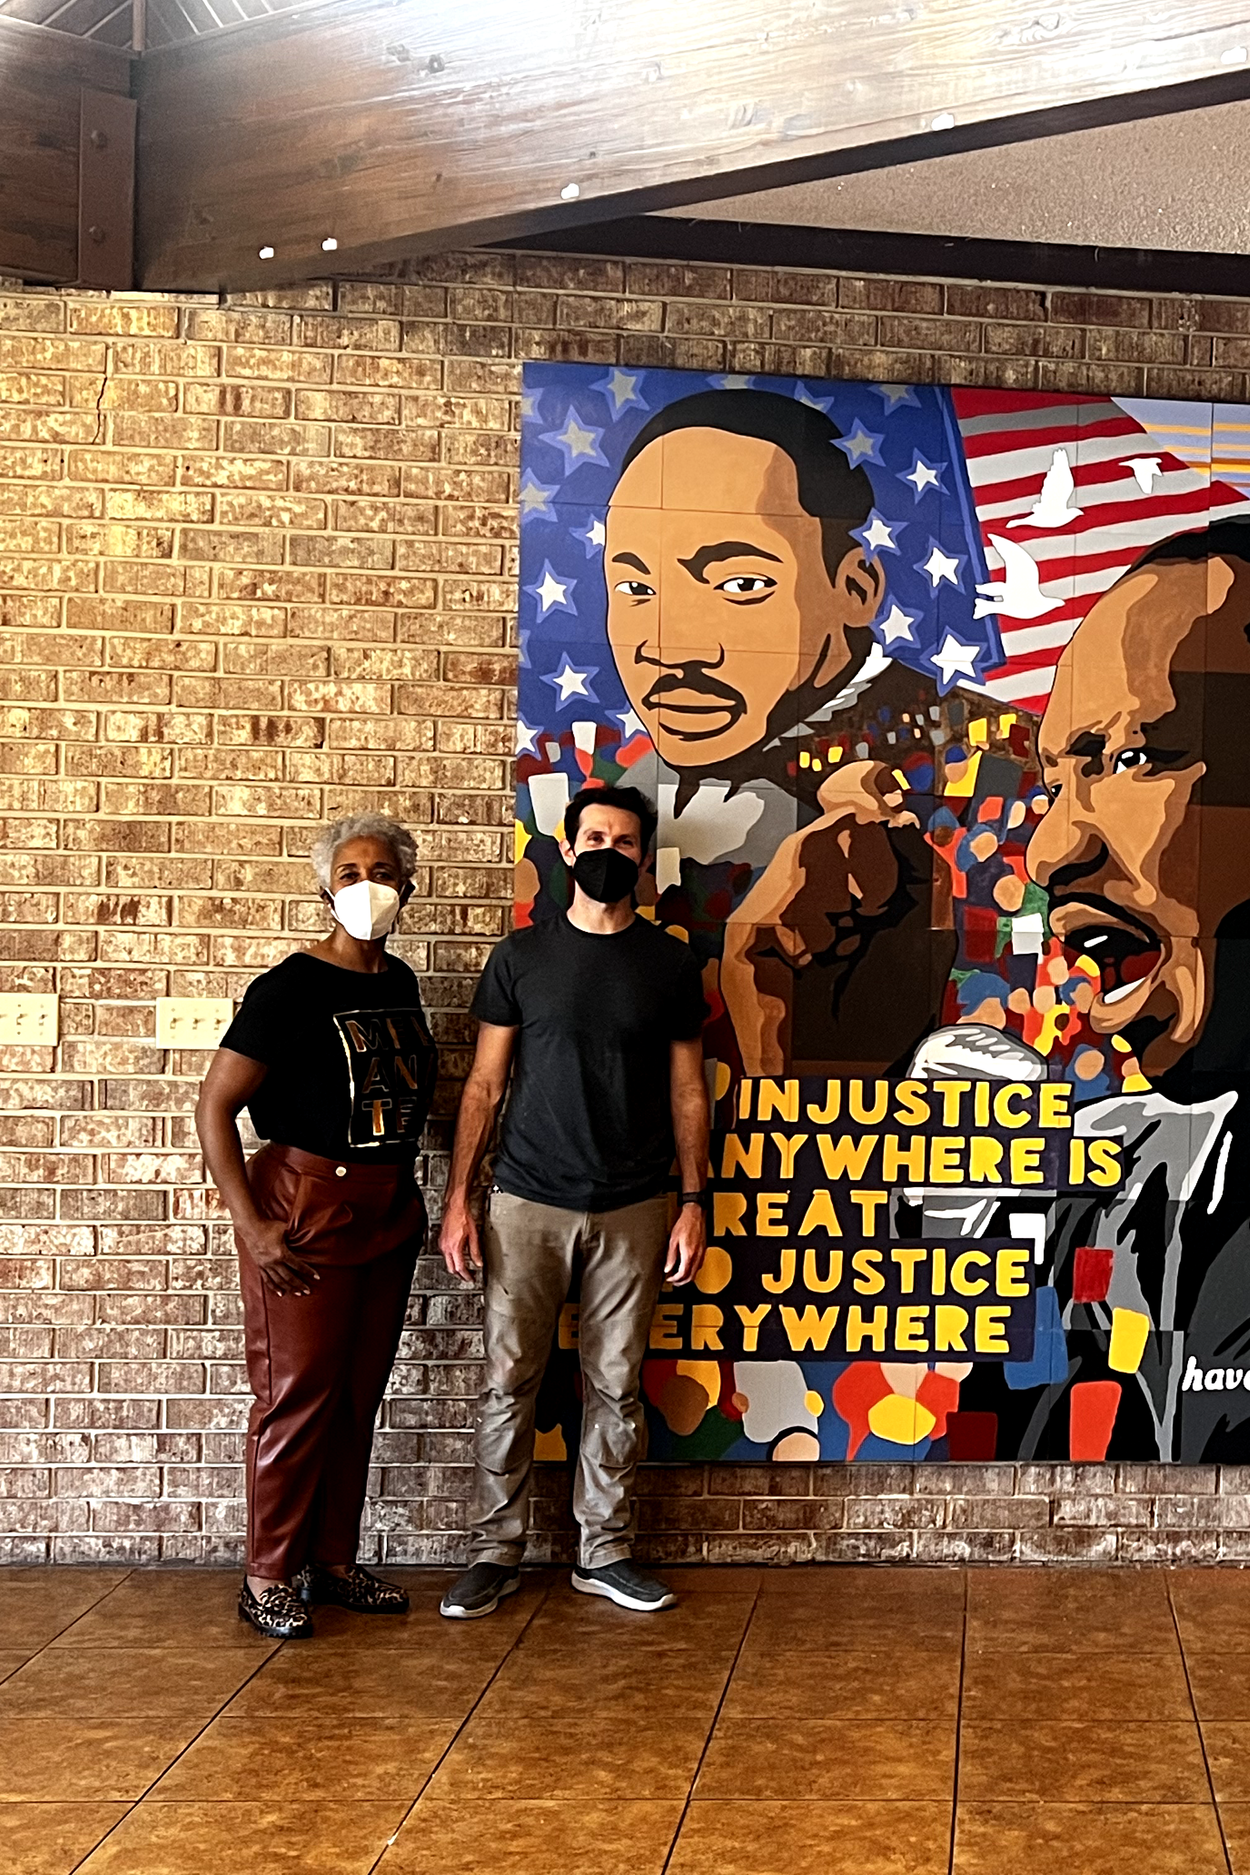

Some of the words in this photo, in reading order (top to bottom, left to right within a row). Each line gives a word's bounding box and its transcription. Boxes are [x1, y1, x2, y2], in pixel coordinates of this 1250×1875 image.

[738, 1078, 1072, 1128] INJUSTICE
[669, 1132, 1045, 1184] NYWHERE
[1068, 1138, 1123, 1187] IS
[667, 1190, 888, 1238] REAT
[761, 1248, 1032, 1297] JUSTICE
[558, 1302, 1011, 1353] EERYWHERE
